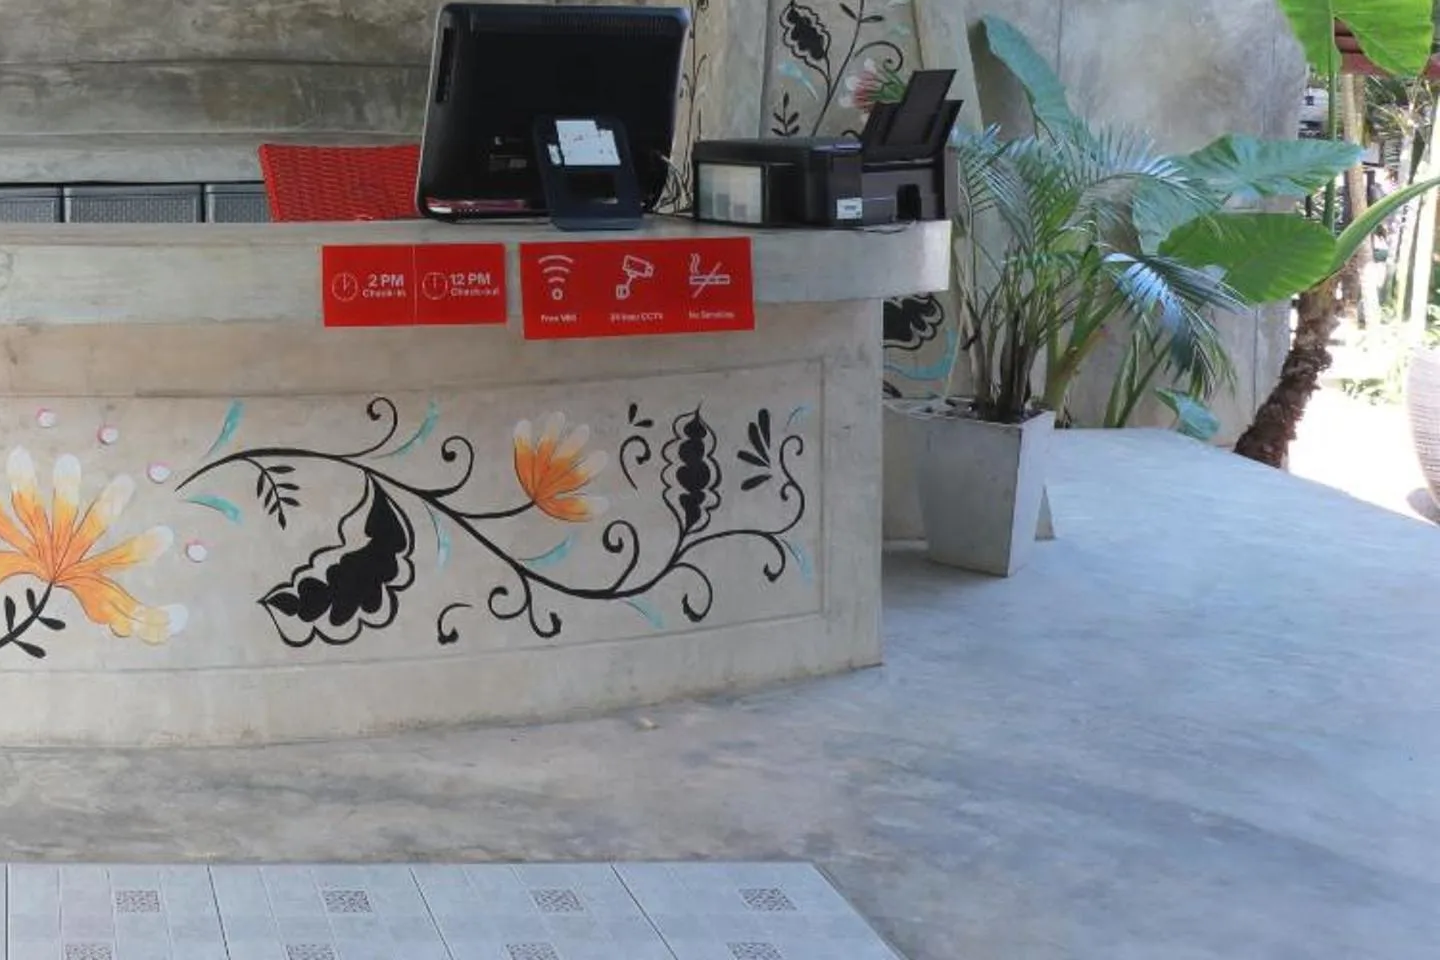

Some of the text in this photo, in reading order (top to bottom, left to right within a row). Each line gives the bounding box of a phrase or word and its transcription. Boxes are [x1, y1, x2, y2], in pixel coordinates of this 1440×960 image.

[367, 273, 405, 288] 2 PM
[449, 272, 491, 286] 12 PM
